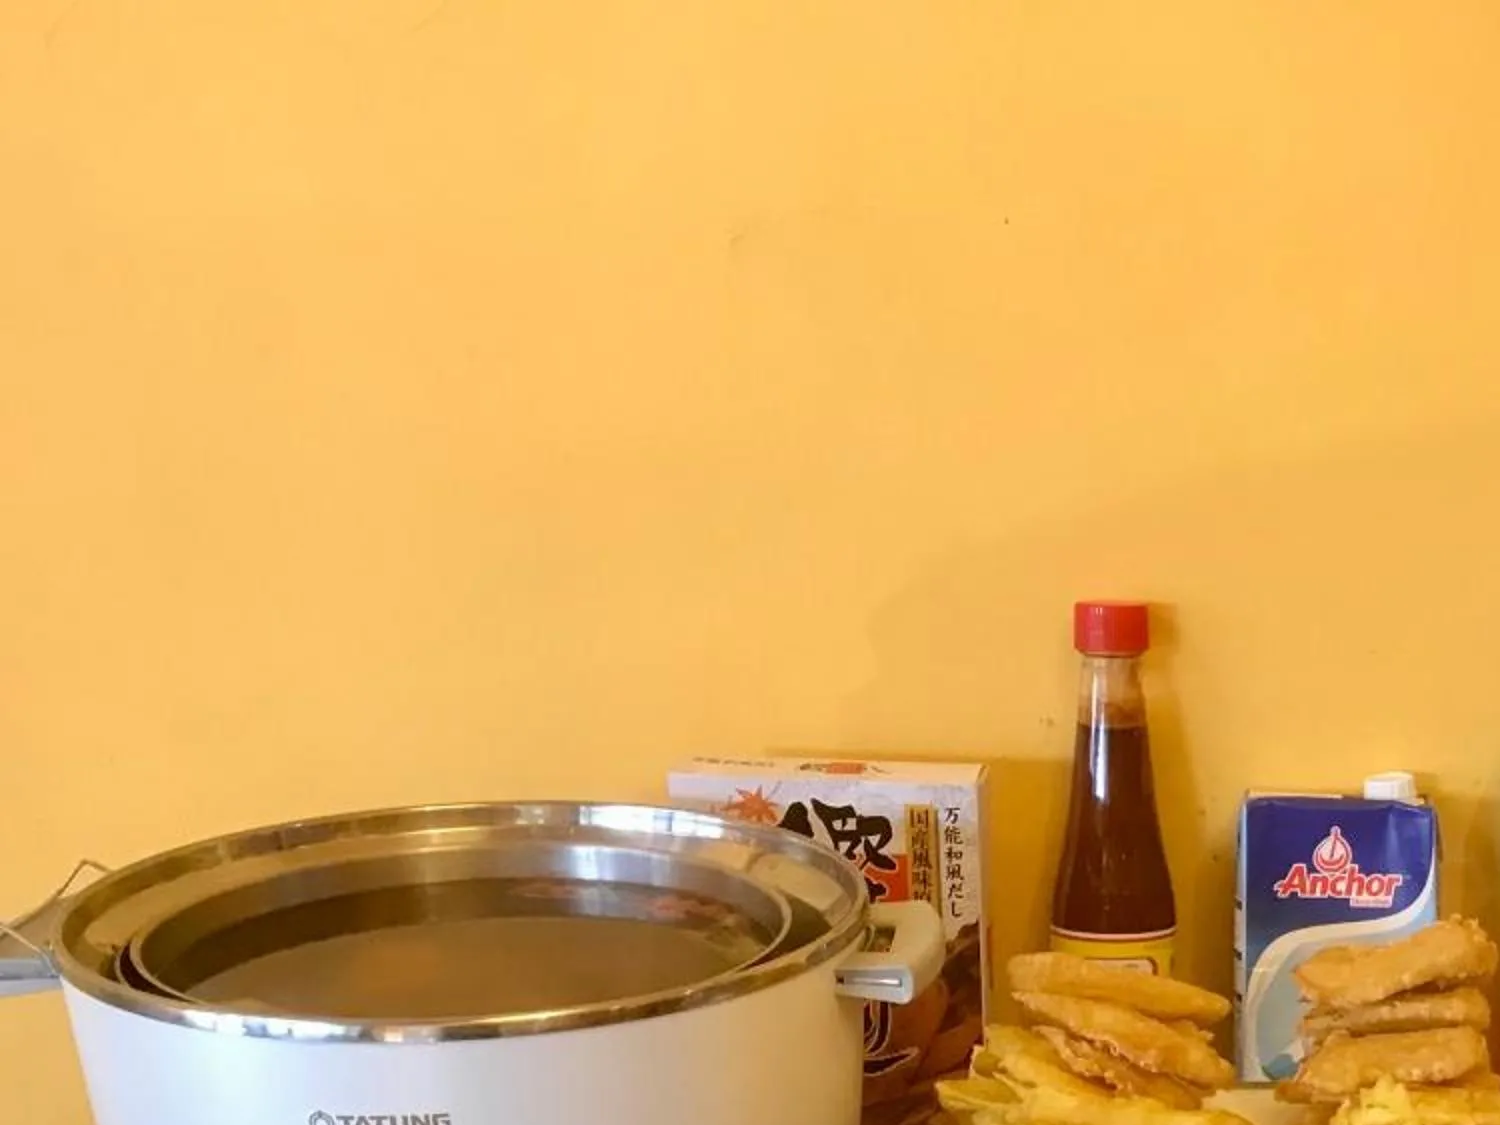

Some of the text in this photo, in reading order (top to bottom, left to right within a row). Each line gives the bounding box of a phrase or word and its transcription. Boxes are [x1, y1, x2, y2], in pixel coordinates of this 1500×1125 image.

[943, 806, 965, 918] 万能和風だし
[1276, 864, 1401, 899] Anchor
